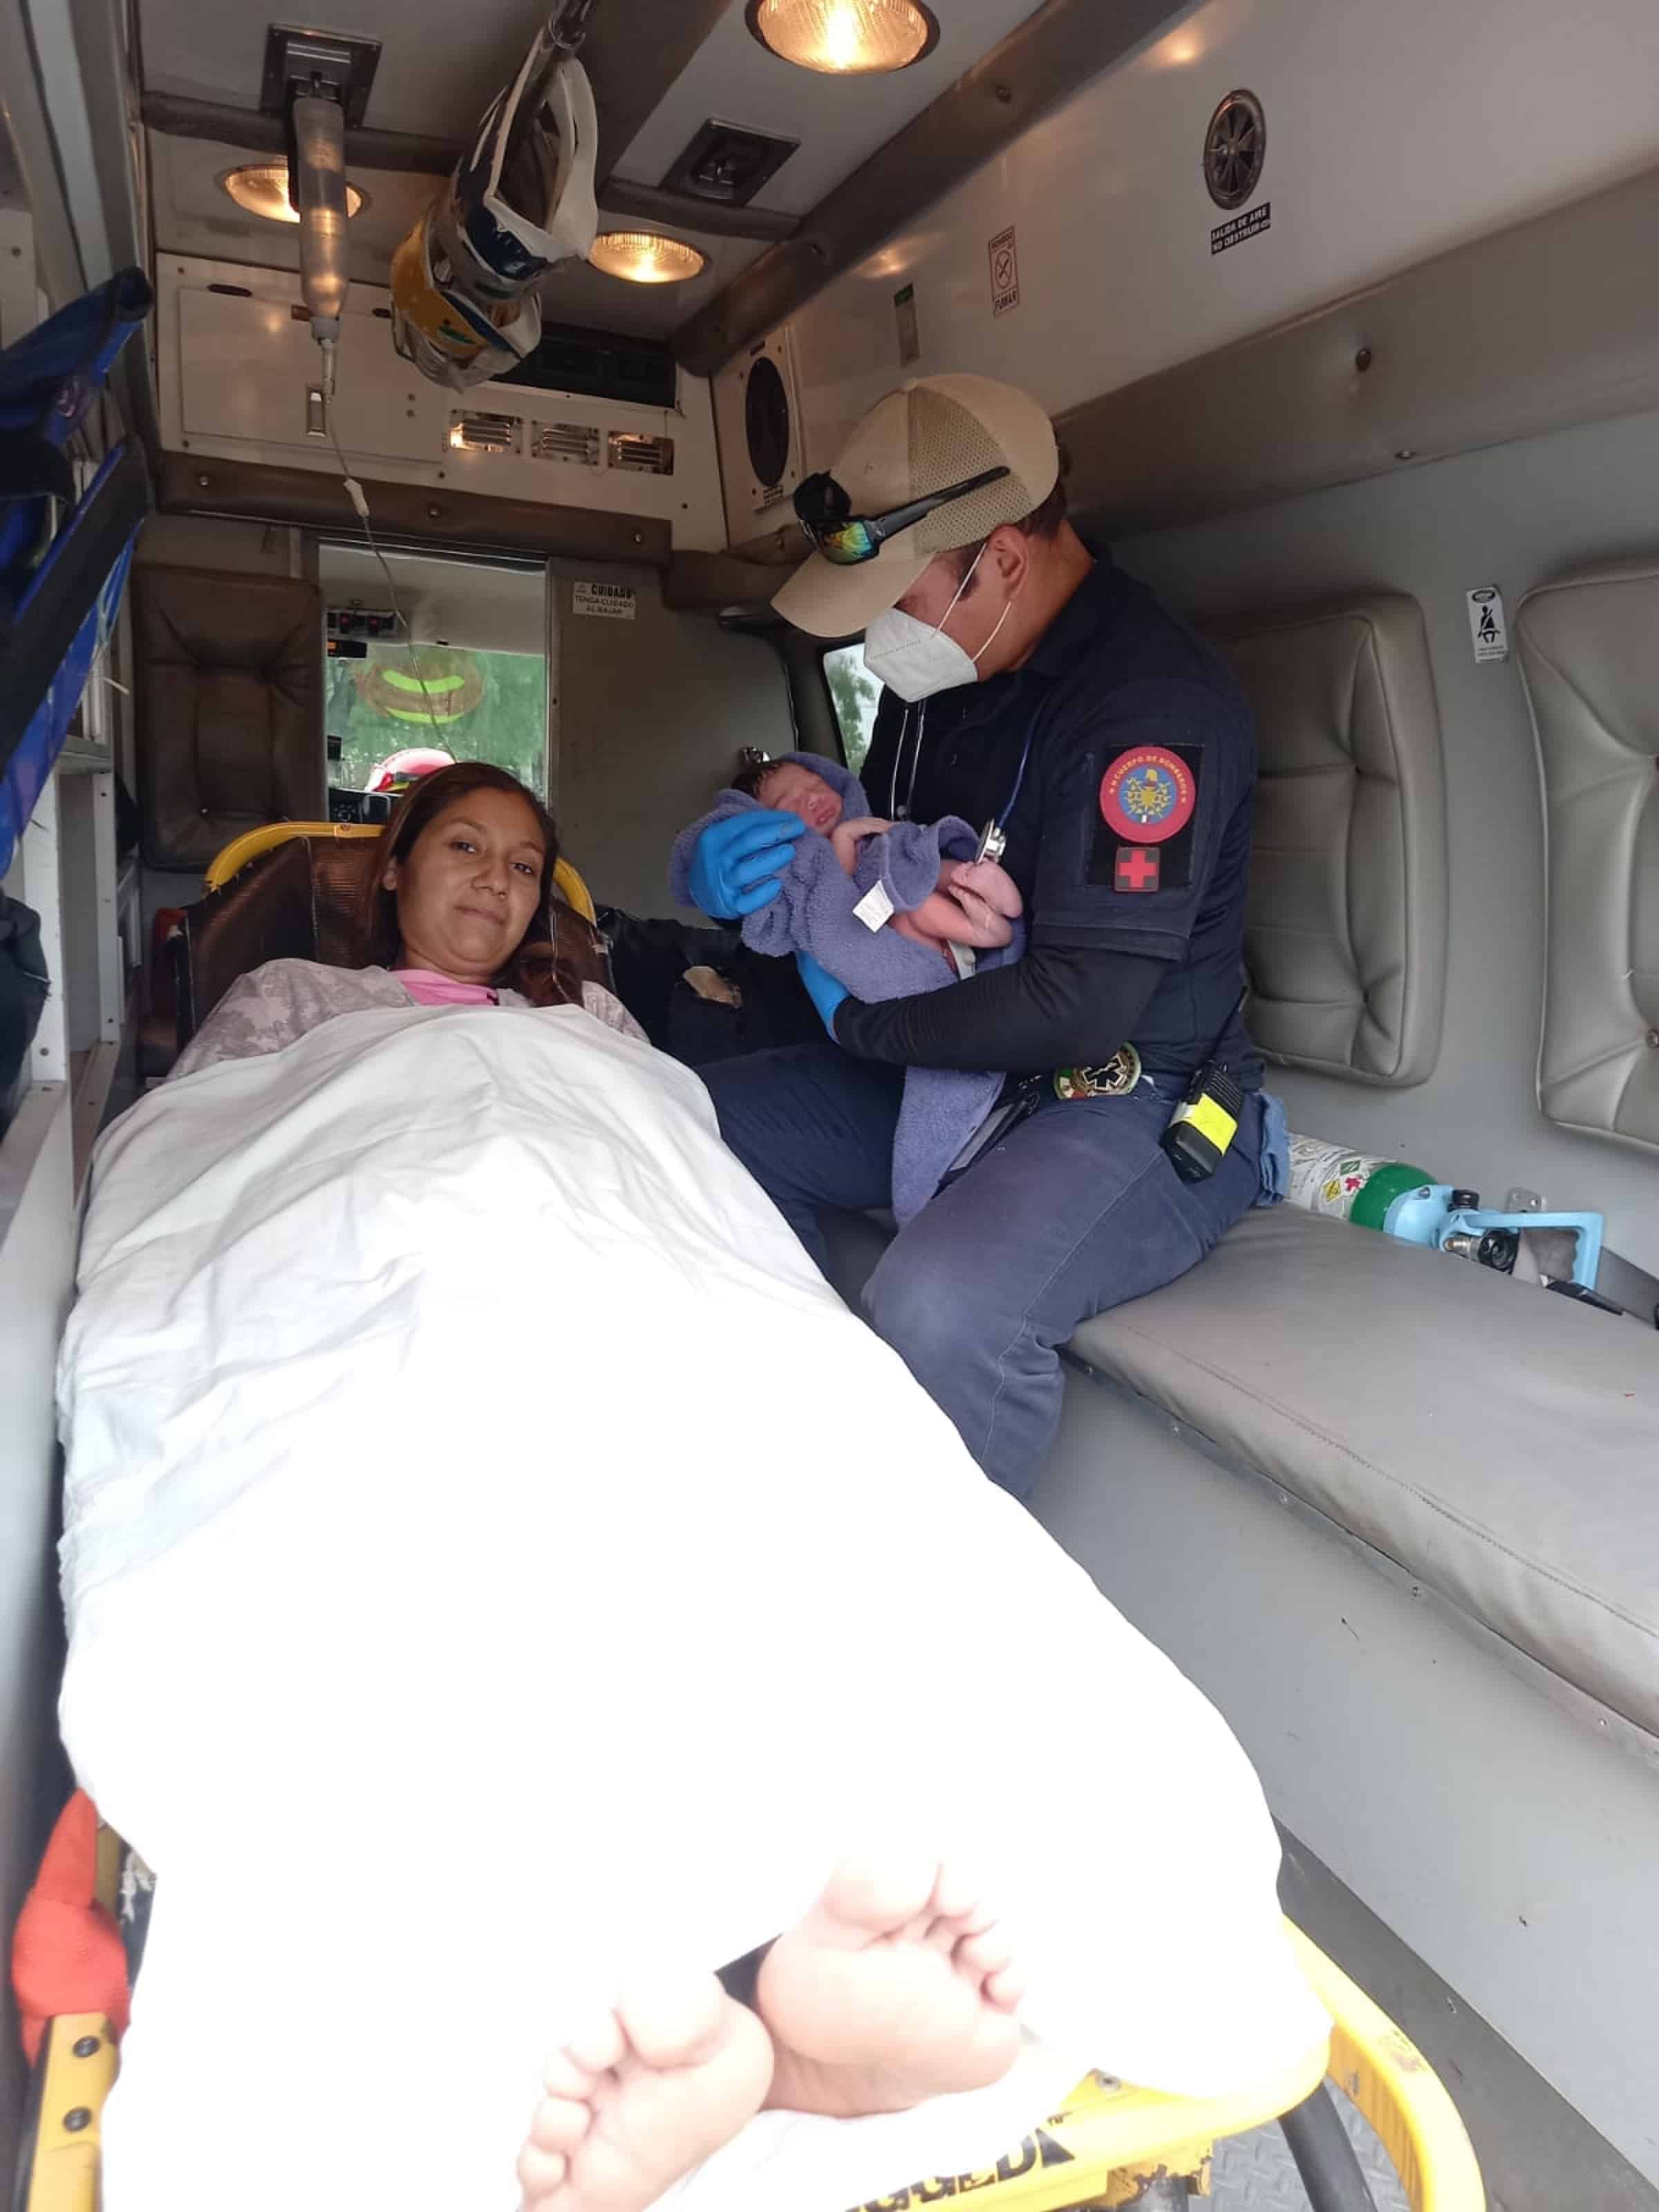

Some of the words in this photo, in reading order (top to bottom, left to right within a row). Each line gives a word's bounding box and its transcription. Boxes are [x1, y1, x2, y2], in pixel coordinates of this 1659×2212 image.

[1212, 223, 1237, 242] SALIDA
[1238, 214, 1248, 229] DE
[1249, 207, 1267, 223] AIRE
[1212, 239, 1223, 252] NO
[591, 584, 632, 599] CUIDADO
[575, 594, 599, 604] TENGA
[1145, 756, 1156, 764] DE
